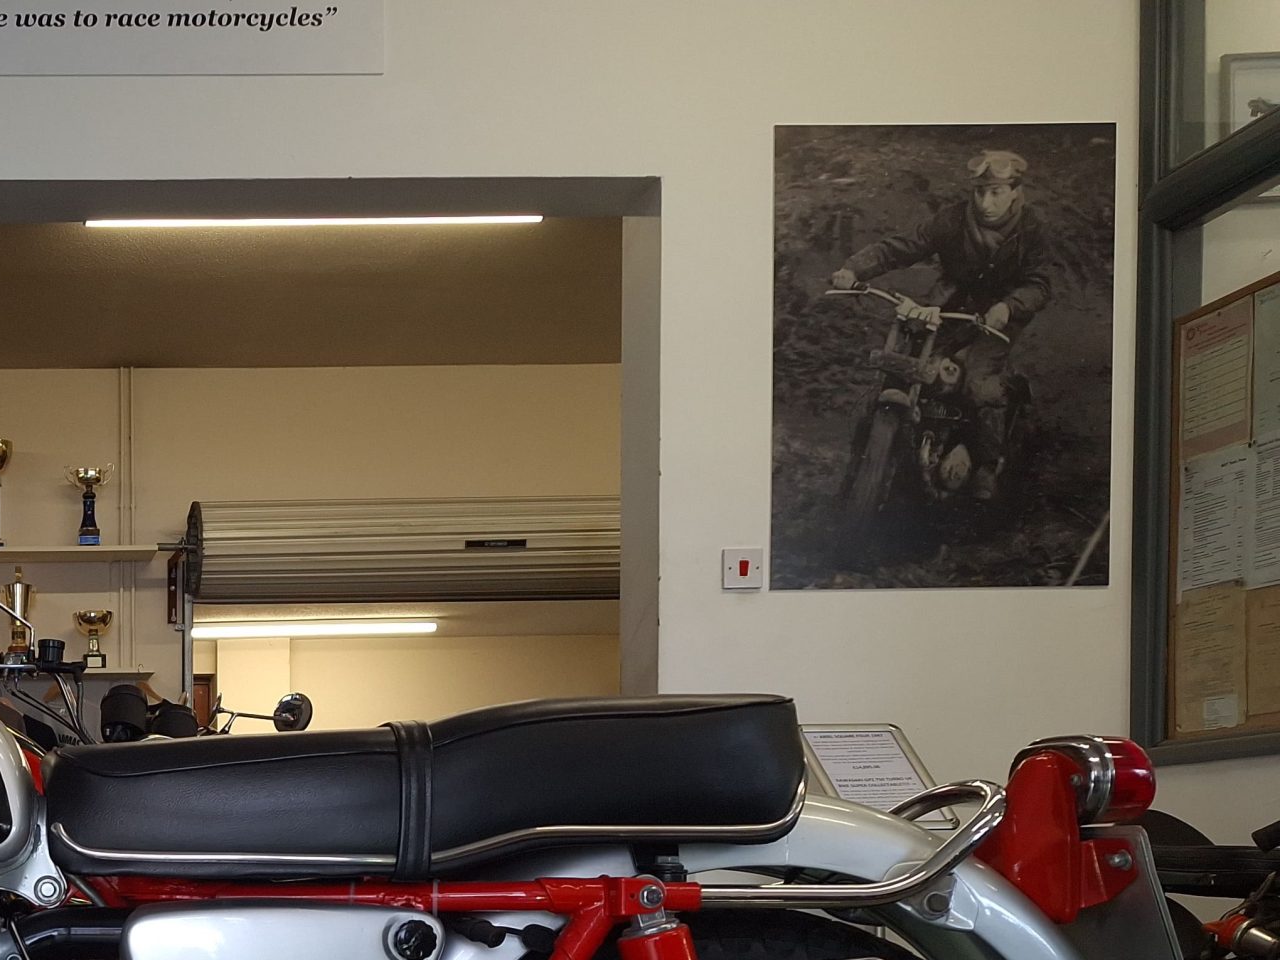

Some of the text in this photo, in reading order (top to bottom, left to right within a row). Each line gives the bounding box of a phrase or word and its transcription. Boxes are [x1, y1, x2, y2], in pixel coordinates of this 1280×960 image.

[15, 11, 67, 28] was
[73, 9, 98, 28] to
[104, 11, 161, 28] race
[58, 734, 81, 746] LOMAS
